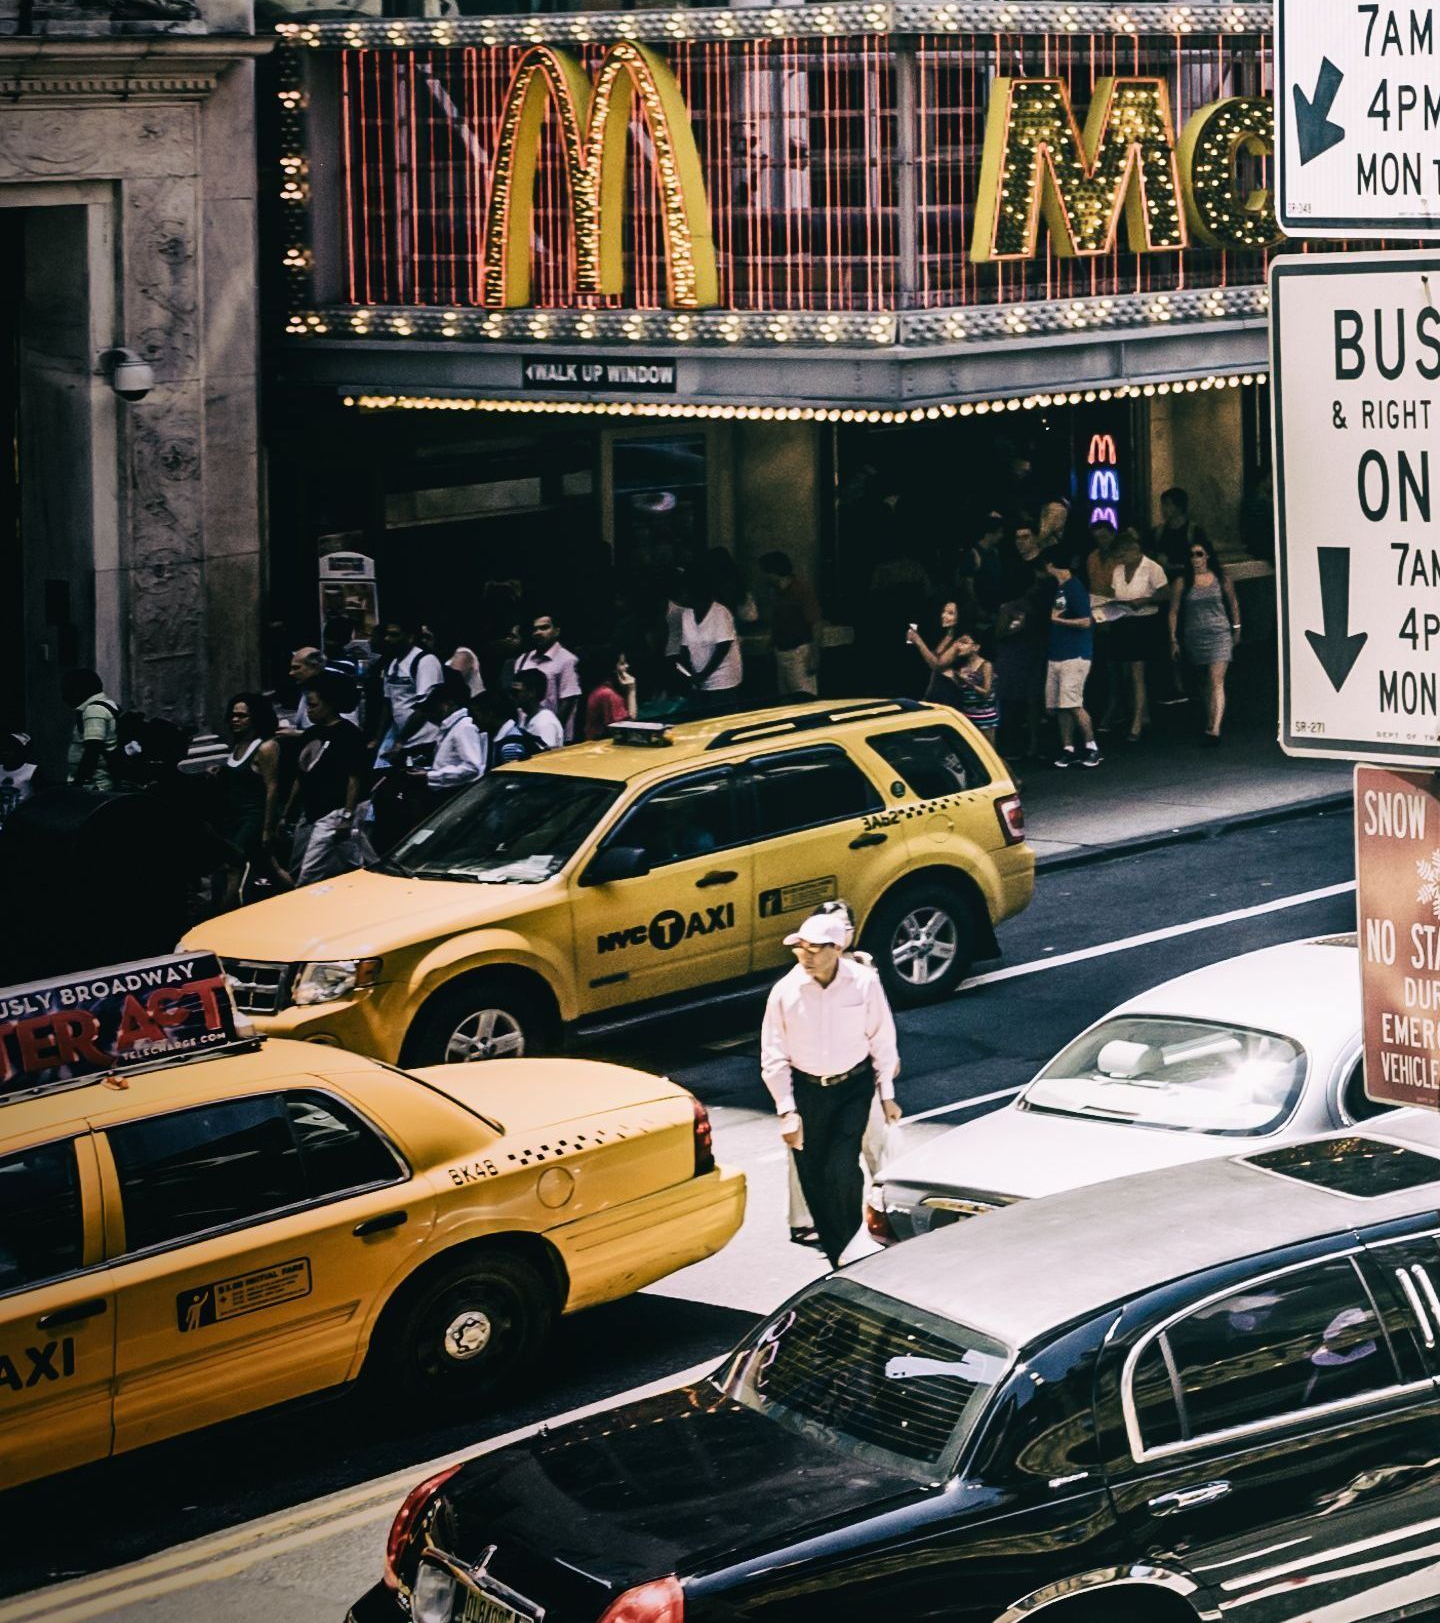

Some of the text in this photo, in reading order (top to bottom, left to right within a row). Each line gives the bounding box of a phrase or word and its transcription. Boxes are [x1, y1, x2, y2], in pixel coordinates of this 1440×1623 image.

[1357, 152, 1422, 196] MON
[535, 364, 674, 383] WALK UP WINDOW
[1332, 400, 1349, 430] &
[1362, 400, 1431, 430] RIGHT
[1379, 671, 1437, 716] MON
[1364, 790, 1427, 840] SNOW
[650, 902, 736, 950] TAXI
[1366, 918, 1397, 966] NO
[59, 961, 196, 1006] BROADWAY
[117, 974, 226, 1051] ACT
